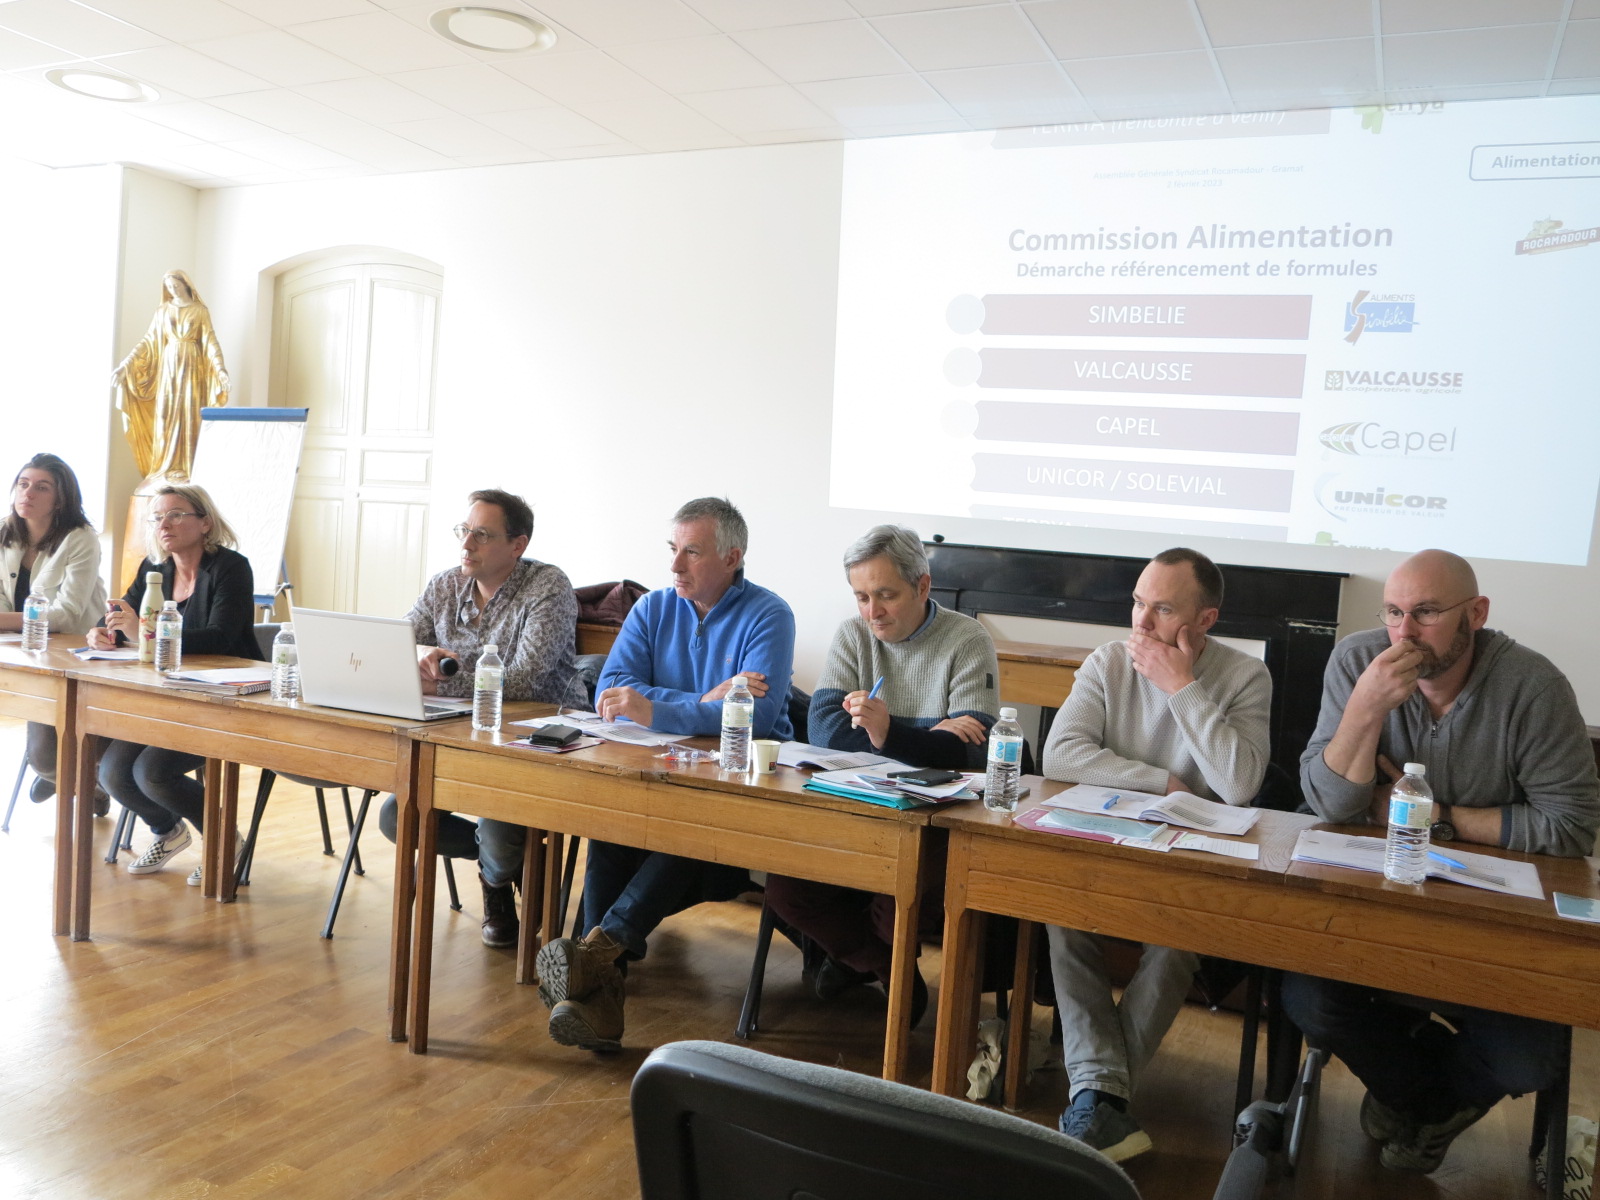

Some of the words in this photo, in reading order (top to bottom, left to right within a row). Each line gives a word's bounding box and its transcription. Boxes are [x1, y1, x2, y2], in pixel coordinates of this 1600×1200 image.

[1491, 153, 1600, 169] Alimentation
[1175, 168, 1209, 178] Syndicat
[1211, 166, 1264, 176] Rocamadour
[1271, 165, 1304, 174] Gramat
[1173, 180, 1200, 189] février
[1201, 179, 1223, 188] 2023
[1008, 226, 1178, 252] Commission
[1187, 222, 1394, 250] Alimentation
[1522, 229, 1598, 251] ROCAMADOUR
[1016, 261, 1106, 278] Démarche
[1110, 260, 1251, 278] référencement
[1256, 259, 1281, 277] de
[1286, 258, 1379, 277] formules
[1370, 293, 1416, 303] ALIMENTS
[1088, 304, 1187, 325] SIMBELIE
[1073, 360, 1194, 382] VALCAUSSE
[1345, 370, 1464, 388] VALCAUSSE
[1415, 387, 1462, 395] agricole
[1095, 415, 1161, 437] CAPEL
[1361, 421, 1457, 456] Capel
[1026, 465, 1106, 489] UNICOR
[1109, 469, 1123, 491] /
[1126, 471, 1228, 496] SOLEVIAL
